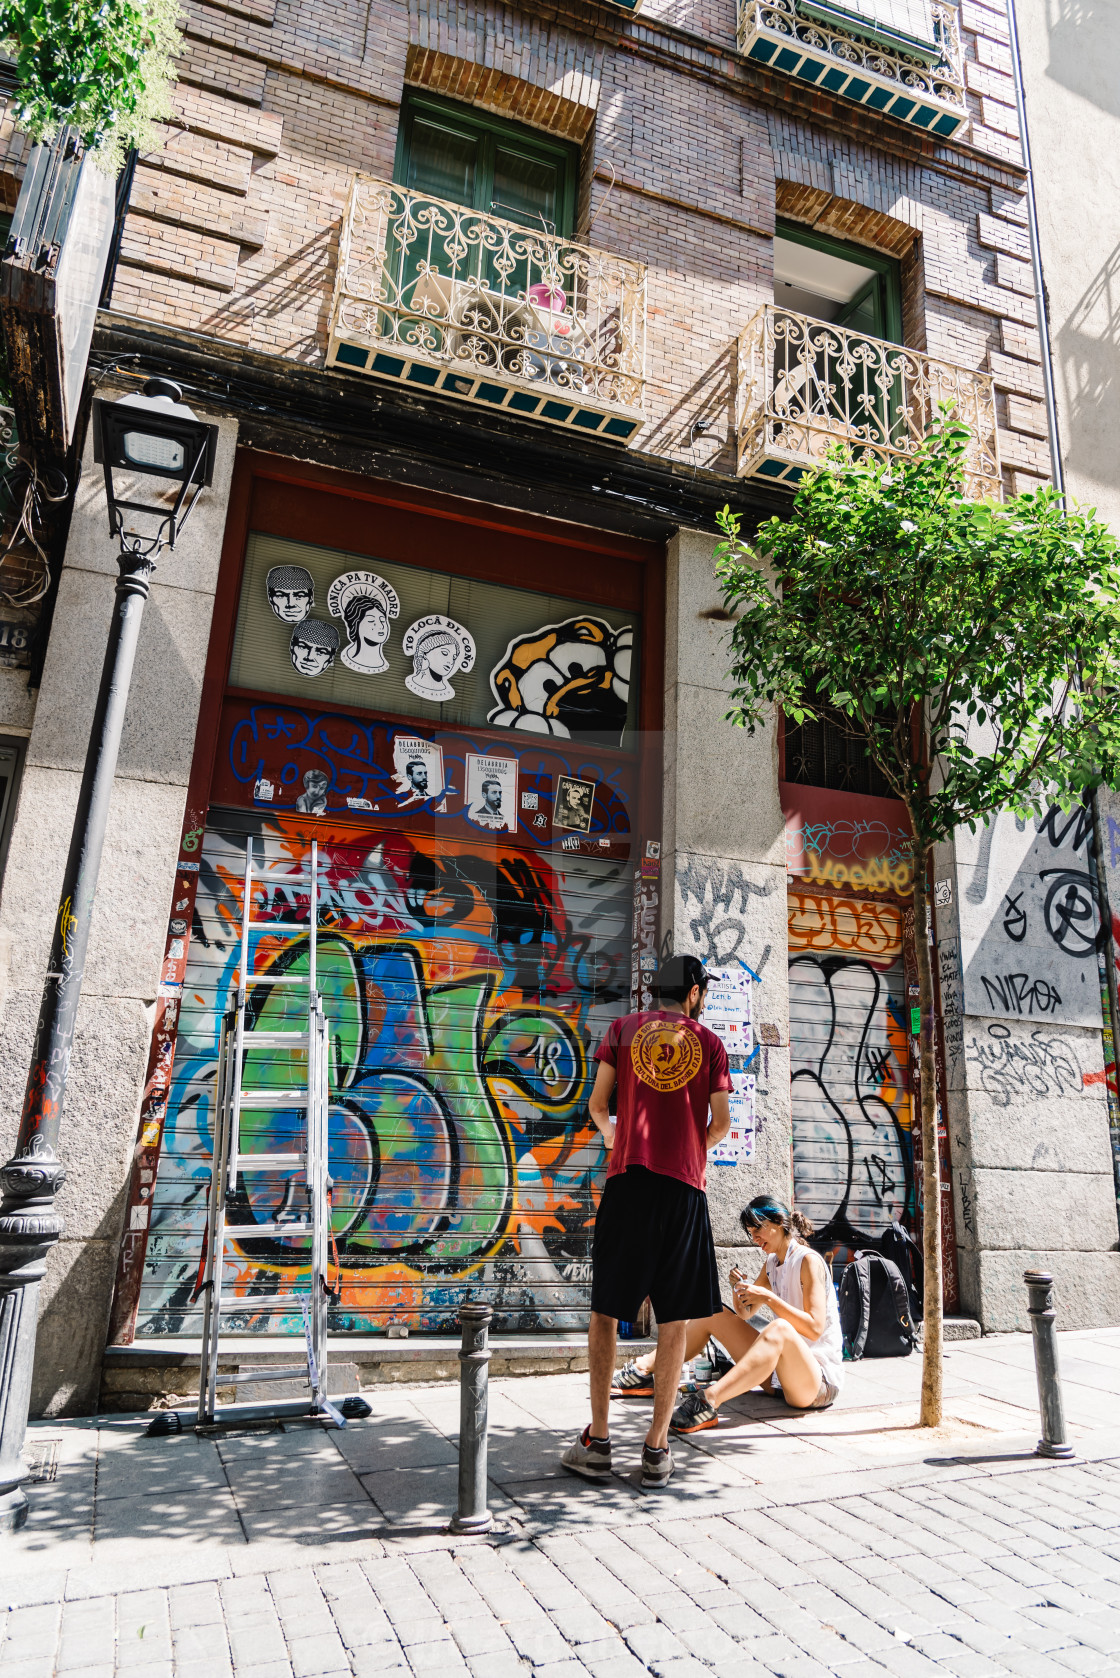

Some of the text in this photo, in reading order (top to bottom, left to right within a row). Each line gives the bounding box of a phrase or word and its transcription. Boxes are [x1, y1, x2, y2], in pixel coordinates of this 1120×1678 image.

[329, 573, 399, 617] BONICA PA TV MADRE
[477, 759, 508, 768] DELABRUJA
[526, 1034, 562, 1086] 18
[636, 1065, 659, 1088] CULTURA
